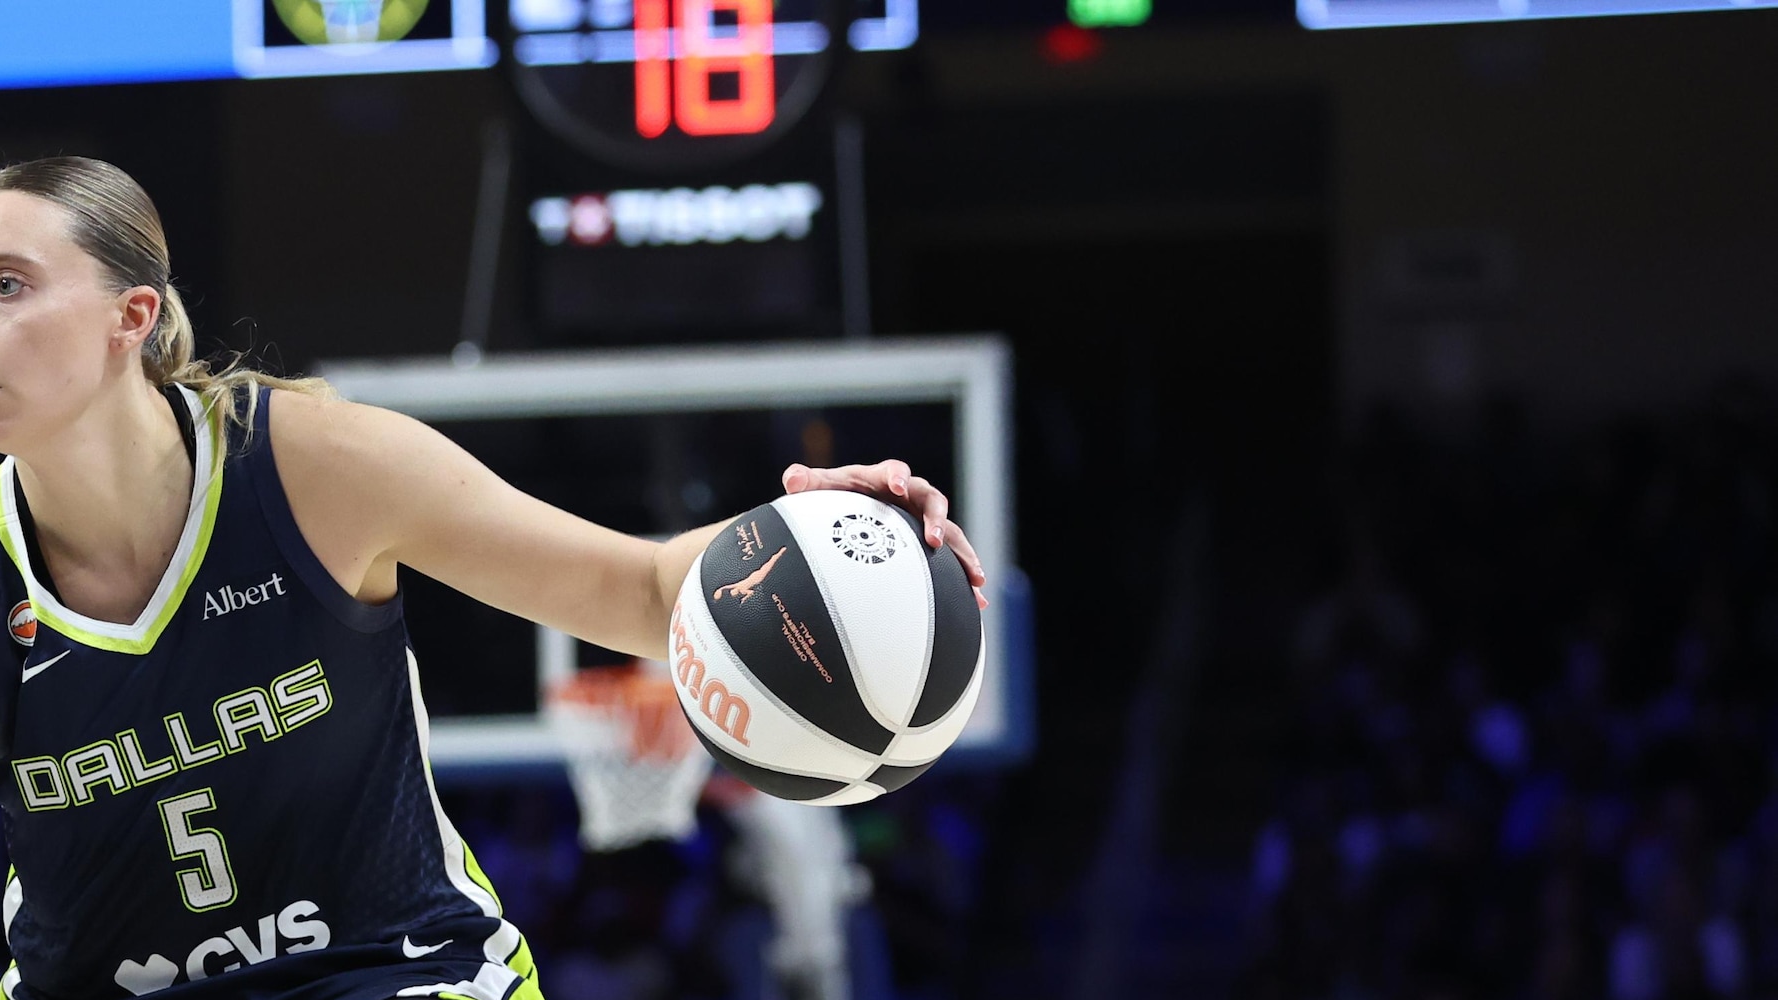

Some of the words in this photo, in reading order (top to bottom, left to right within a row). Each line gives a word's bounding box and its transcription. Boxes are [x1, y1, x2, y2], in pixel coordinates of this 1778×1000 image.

[634, 0, 775, 138] 18
[202, 573, 286, 620] Albert
[771, 593, 785, 612] CUP
[799, 622, 816, 646] BALL
[673, 586, 751, 748] Wilso
[782, 624, 807, 662] OFFICIAL
[11, 659, 333, 812] DALLAS
[157, 788, 237, 913] 5
[186, 900, 331, 977] CVS
